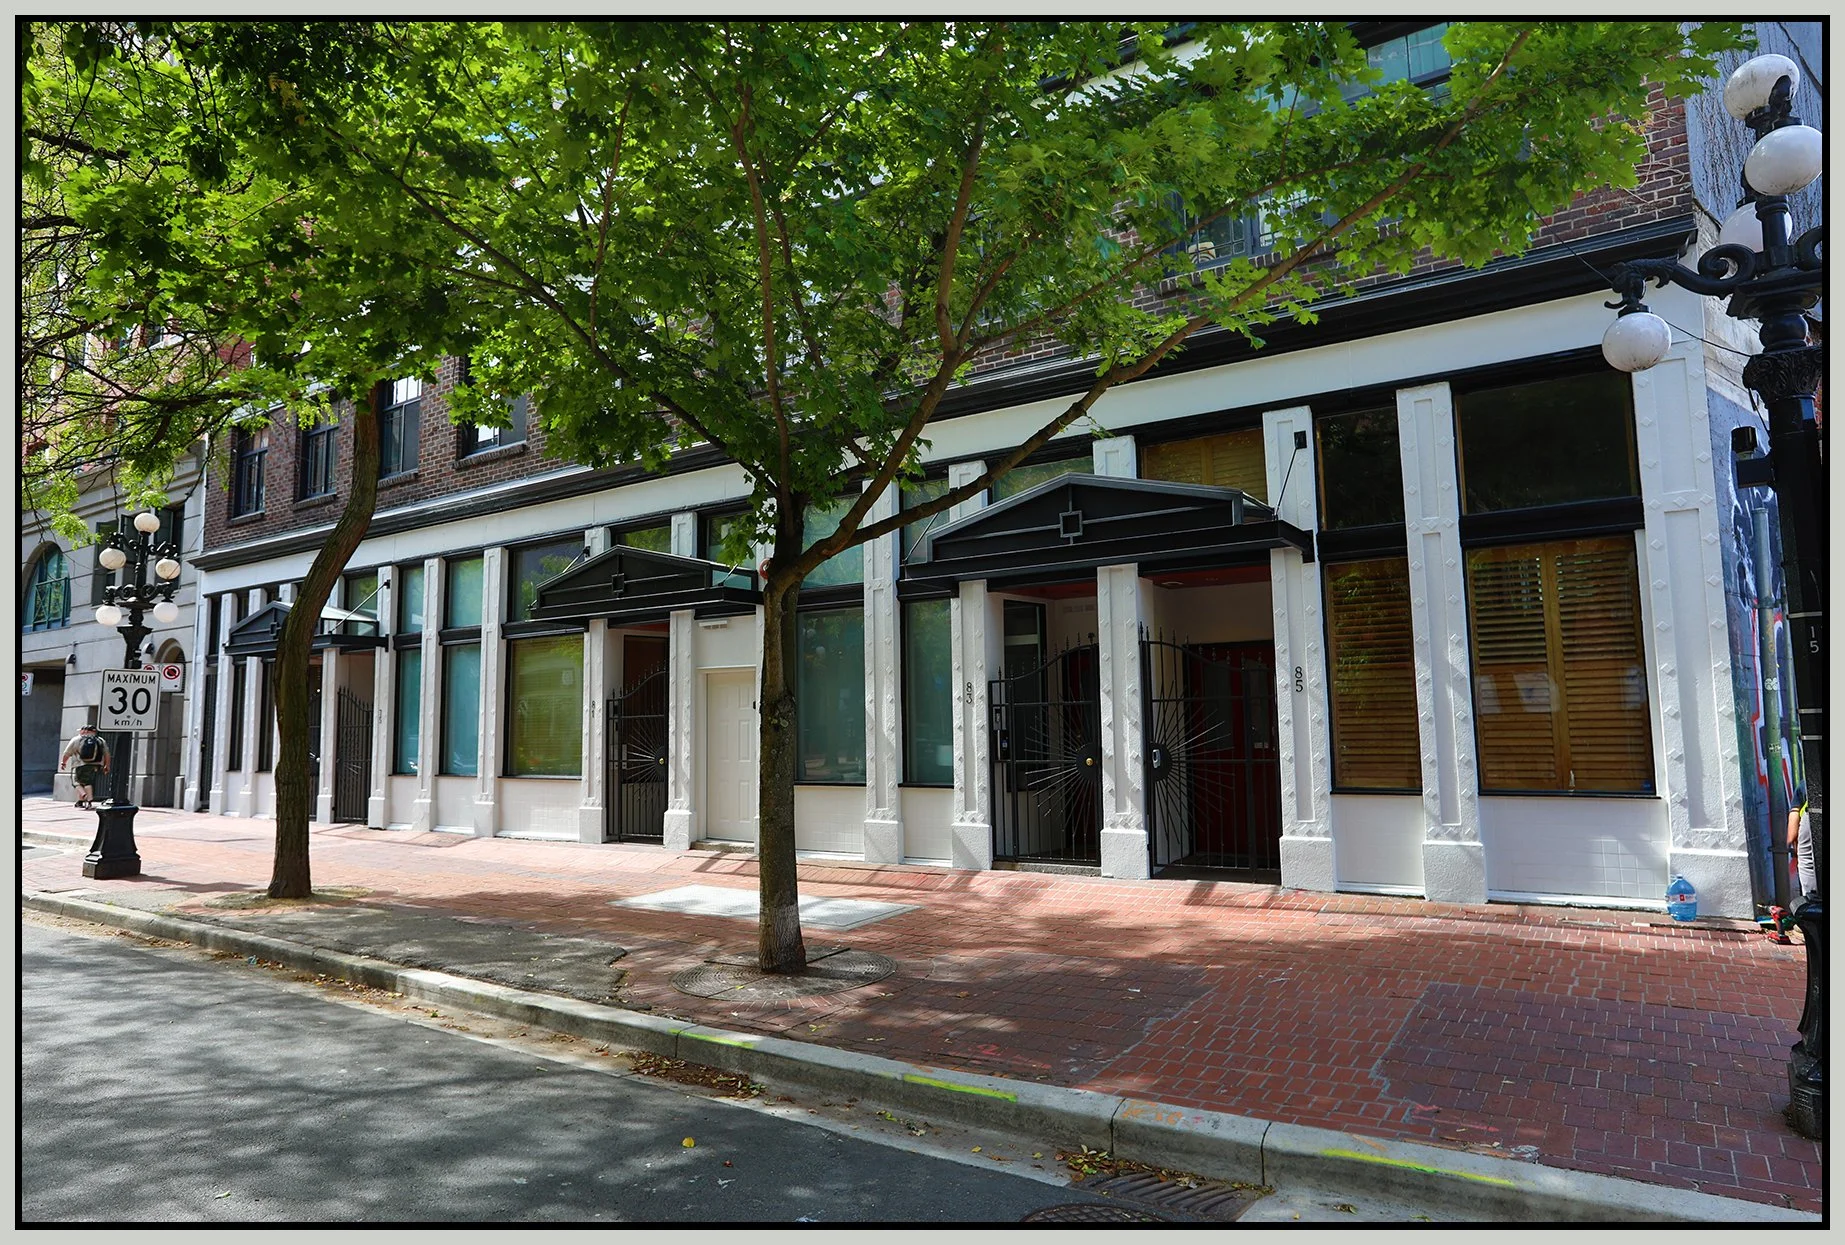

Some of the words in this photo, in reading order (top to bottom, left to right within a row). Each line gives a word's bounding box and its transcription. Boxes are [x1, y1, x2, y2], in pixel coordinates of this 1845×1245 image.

[107, 674, 156, 684] MAXIMUM
[1294, 665, 1304, 693] 85
[108, 687, 151, 715] 30
[965, 681, 973, 704] 83
